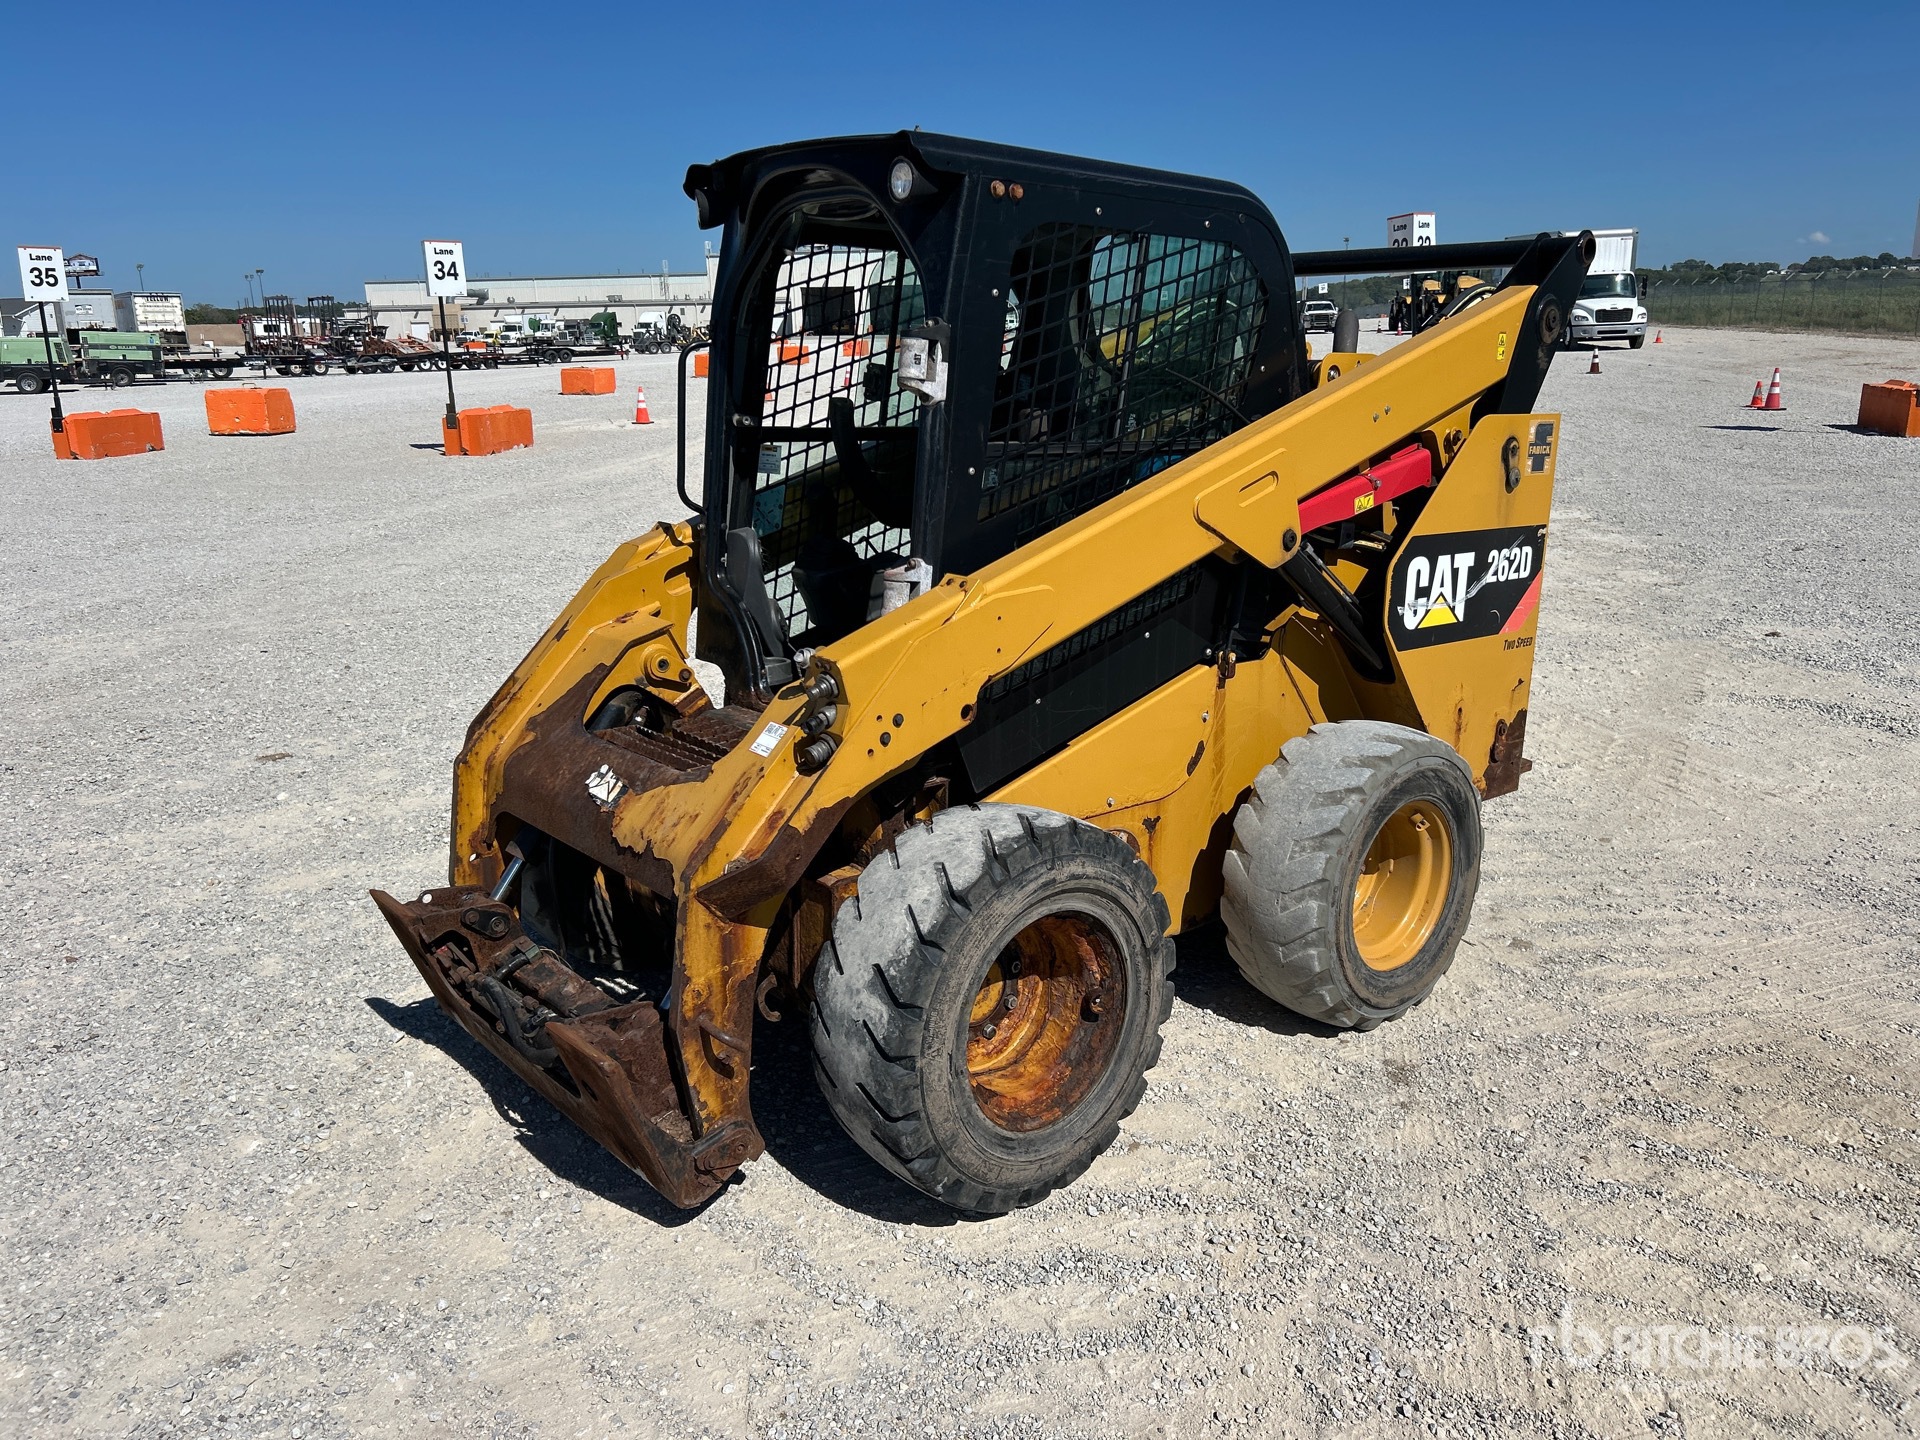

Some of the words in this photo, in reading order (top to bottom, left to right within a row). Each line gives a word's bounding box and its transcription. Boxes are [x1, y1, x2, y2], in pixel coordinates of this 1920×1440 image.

[1393, 224, 1407, 232] Lane
[29, 253, 53, 261] Lane
[434, 247, 454, 255] Lane
[29, 266, 59, 288] 35
[433, 260, 459, 281] 34
[914, 353, 922, 366] CAT
[1528, 444, 1551, 456] FABICK
[1487, 546, 1533, 583] 262D
[1403, 551, 1476, 631] CAT
